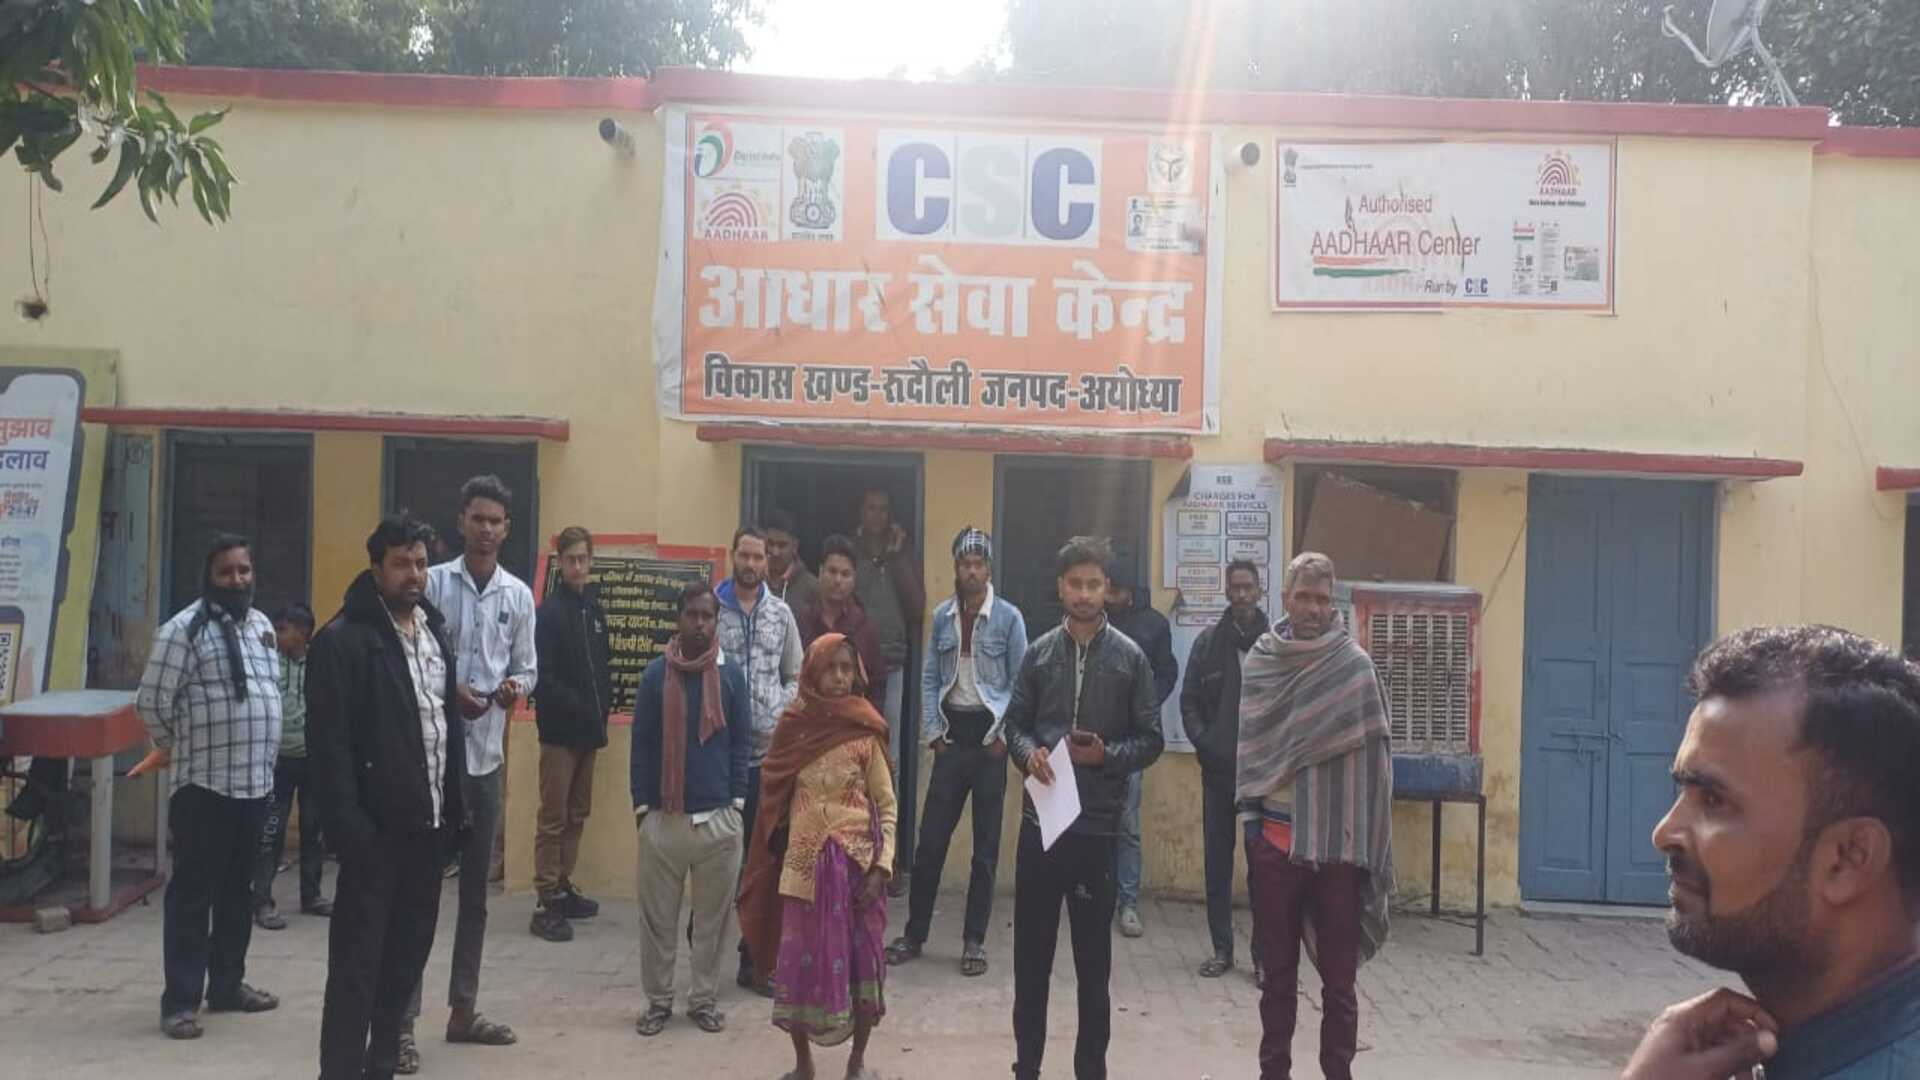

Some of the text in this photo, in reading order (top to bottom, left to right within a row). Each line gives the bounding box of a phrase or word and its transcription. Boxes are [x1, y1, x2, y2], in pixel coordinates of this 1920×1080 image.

[886, 141, 1096, 241] CSC
[1359, 193, 1432, 214] Authorised
[704, 228, 768, 241] AADHAAR
[1310, 230, 1481, 256] AADHAAR Center
[700, 254, 1194, 345] आधार सेवा केन्द्र
[704, 353, 796, 399] विकास
[980, 364, 1183, 413] जनपद-अयोध्या
